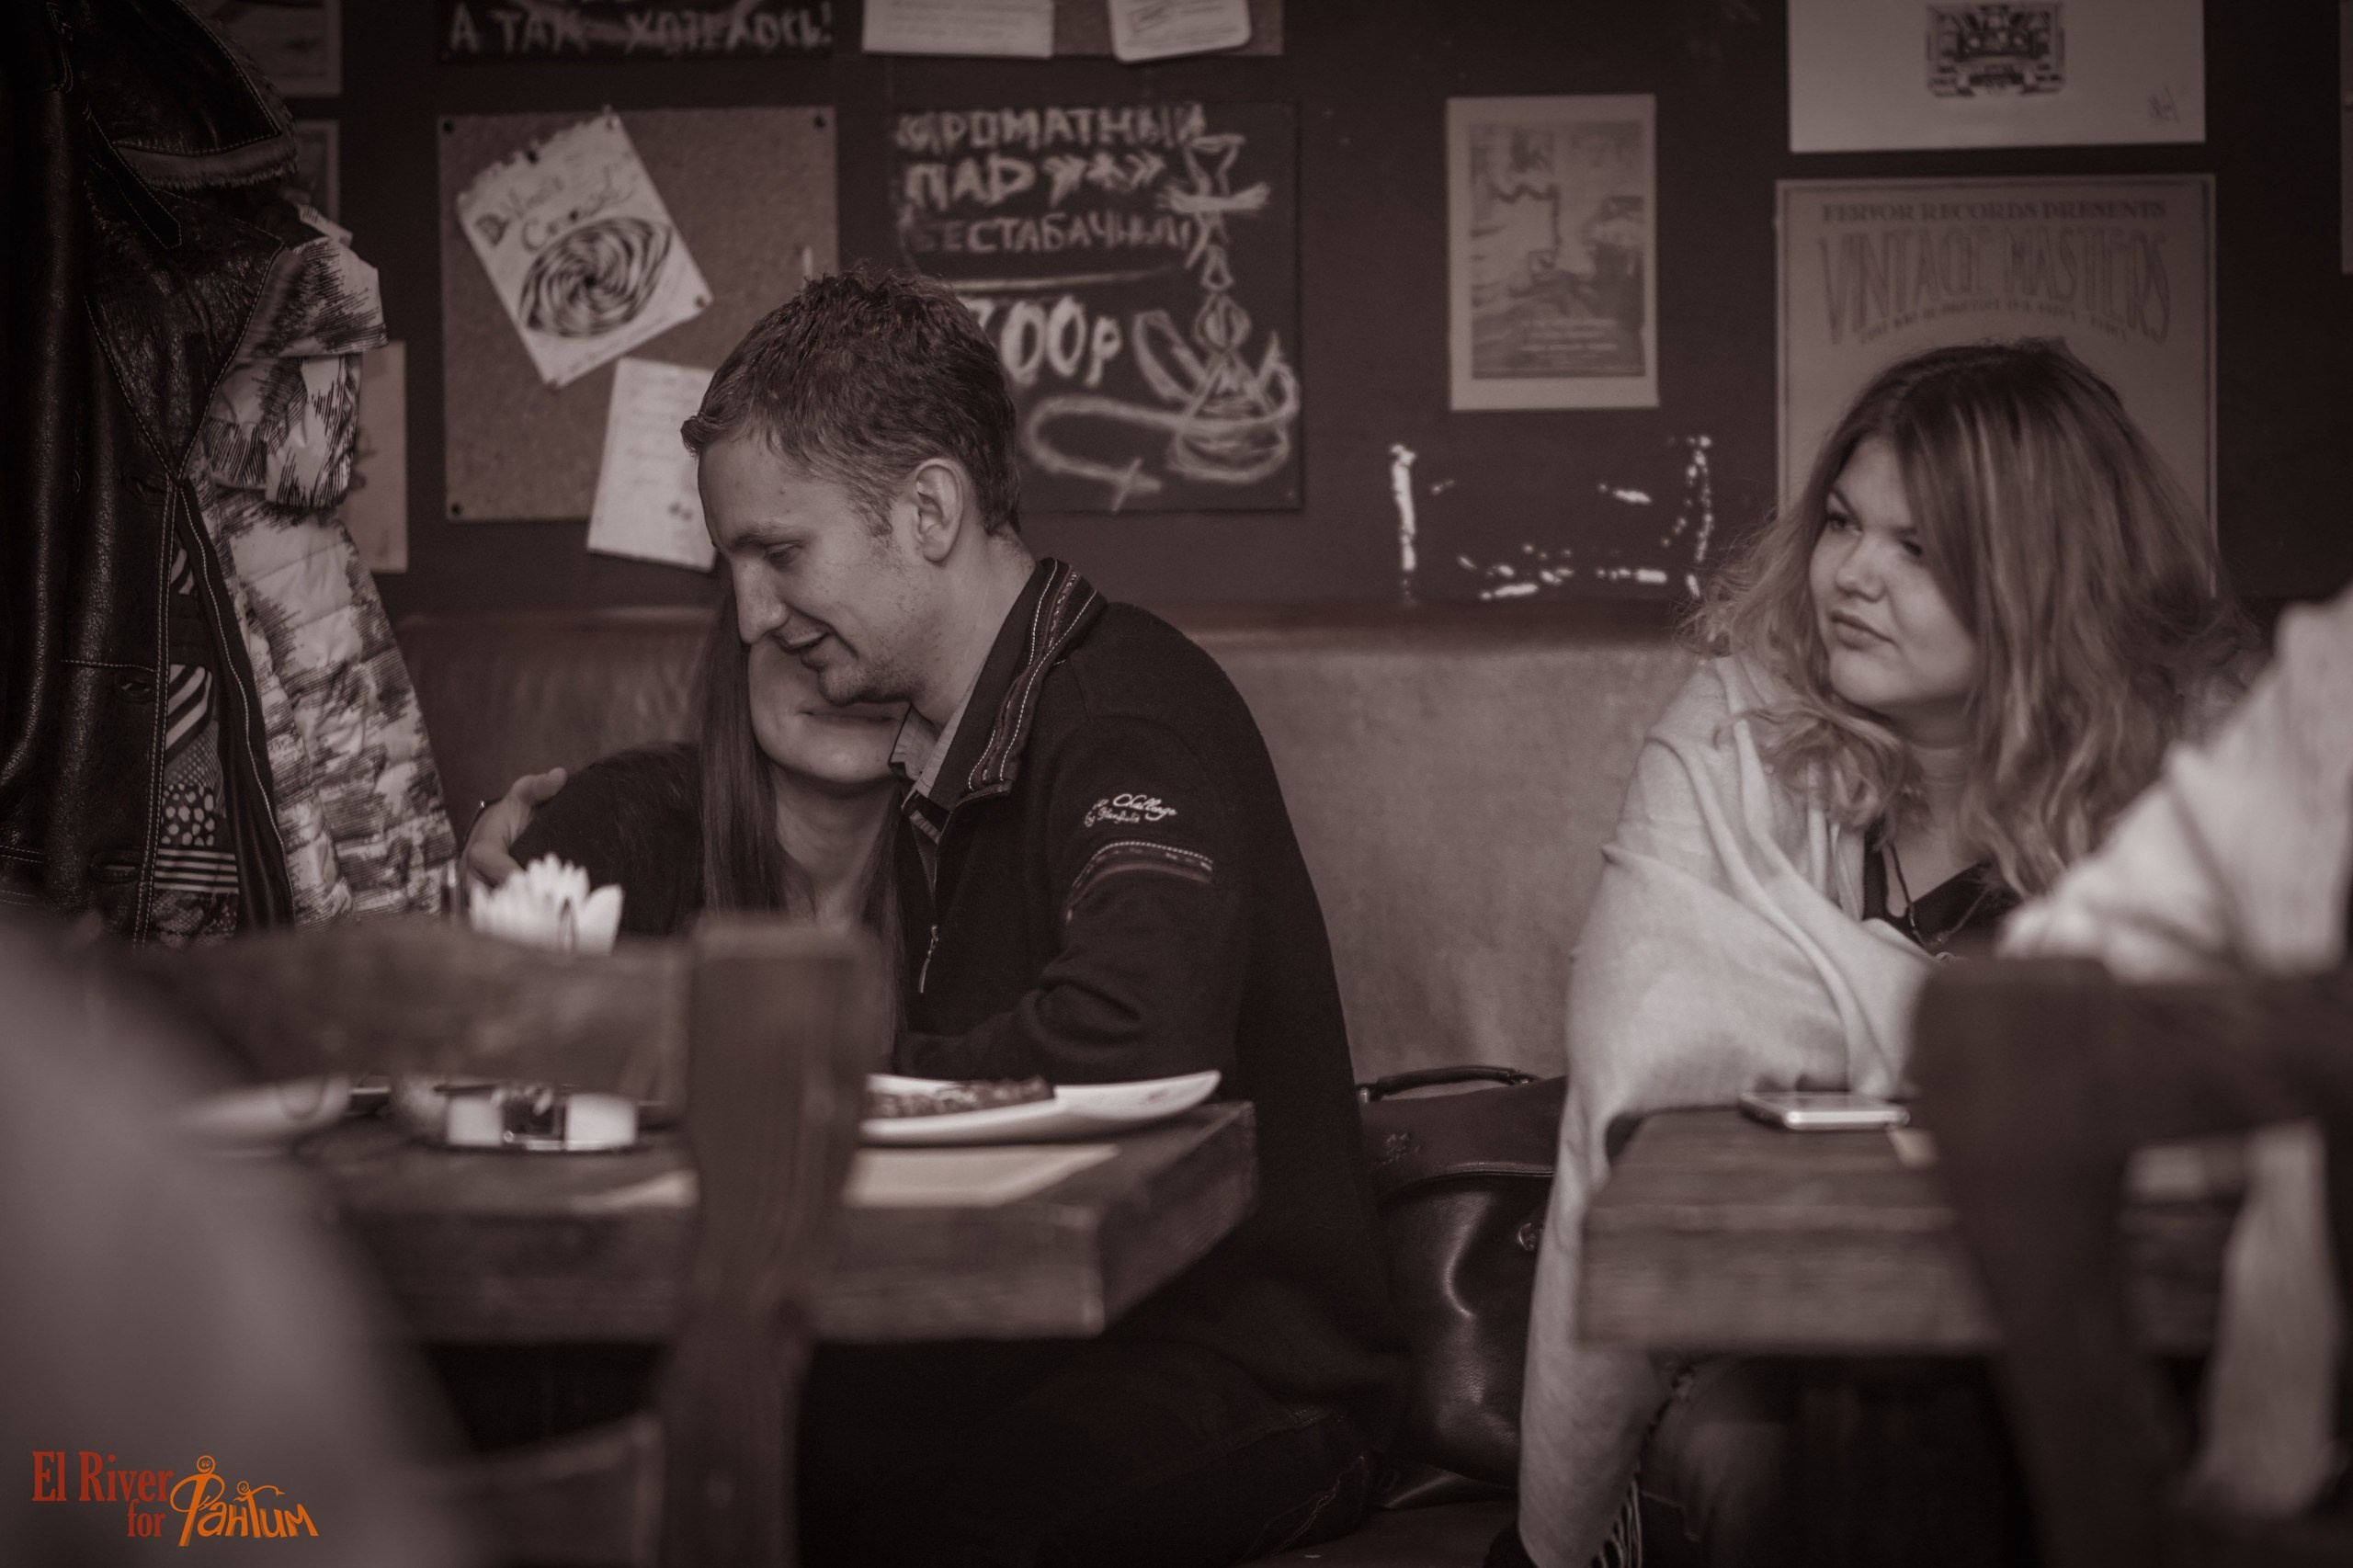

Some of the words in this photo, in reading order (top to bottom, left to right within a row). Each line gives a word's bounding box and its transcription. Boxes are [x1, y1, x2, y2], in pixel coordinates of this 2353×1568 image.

[448, 2, 481, 54] А
[489, 5, 591, 55] ТАК
[904, 153, 1037, 211] ПАР
[1921, 202, 2038, 221] RECORDS
[2042, 199, 2167, 219] PRESENTS
[1818, 225, 1993, 346] VINTAGE
[2004, 224, 2173, 346] MASTERS
